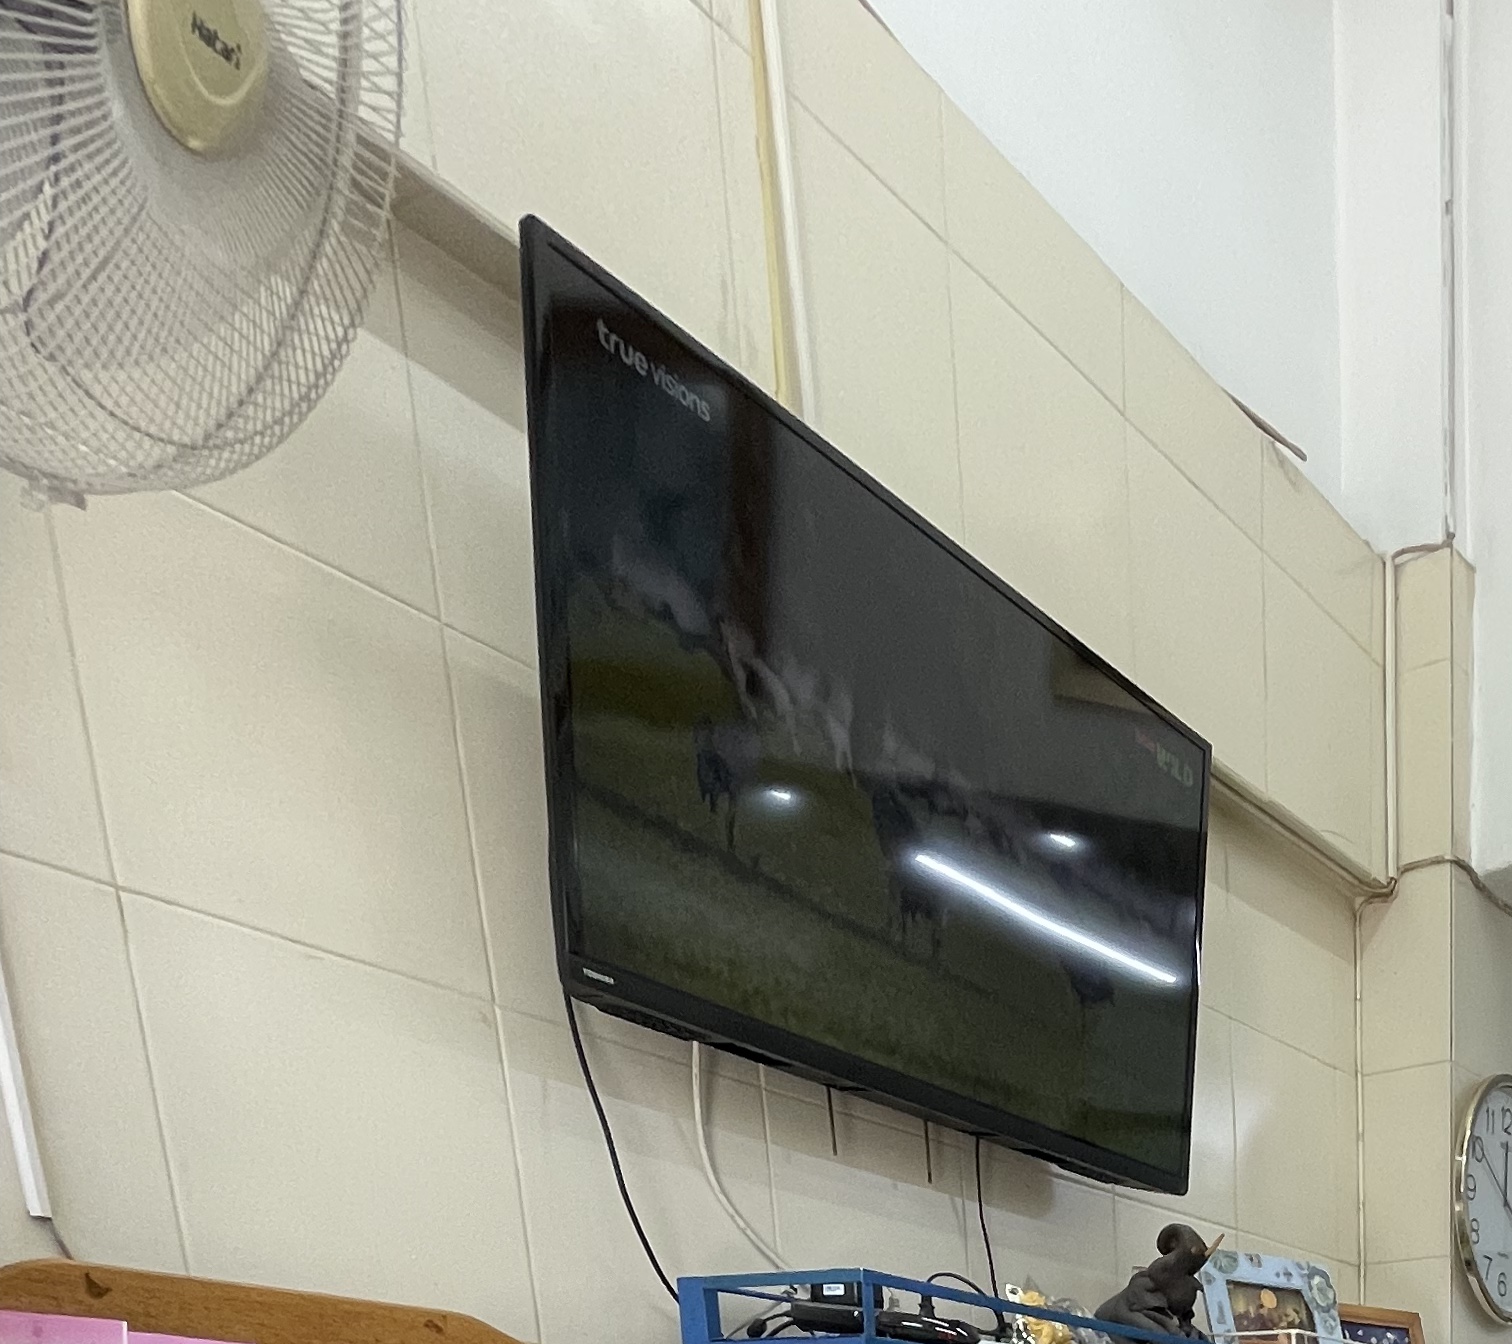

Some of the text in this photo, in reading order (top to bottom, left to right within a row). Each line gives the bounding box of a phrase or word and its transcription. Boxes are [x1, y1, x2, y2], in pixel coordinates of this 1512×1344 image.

[597, 319, 711, 422] true visions
[1485, 1106, 1495, 1135] 11
[1501, 1107, 1512, 1136] 12
[1466, 1174, 1477, 1201] 9
[1470, 1218, 1480, 1245] 8
[1483, 1255, 1493, 1281] 7
[1497, 1272, 1507, 1297] 6
